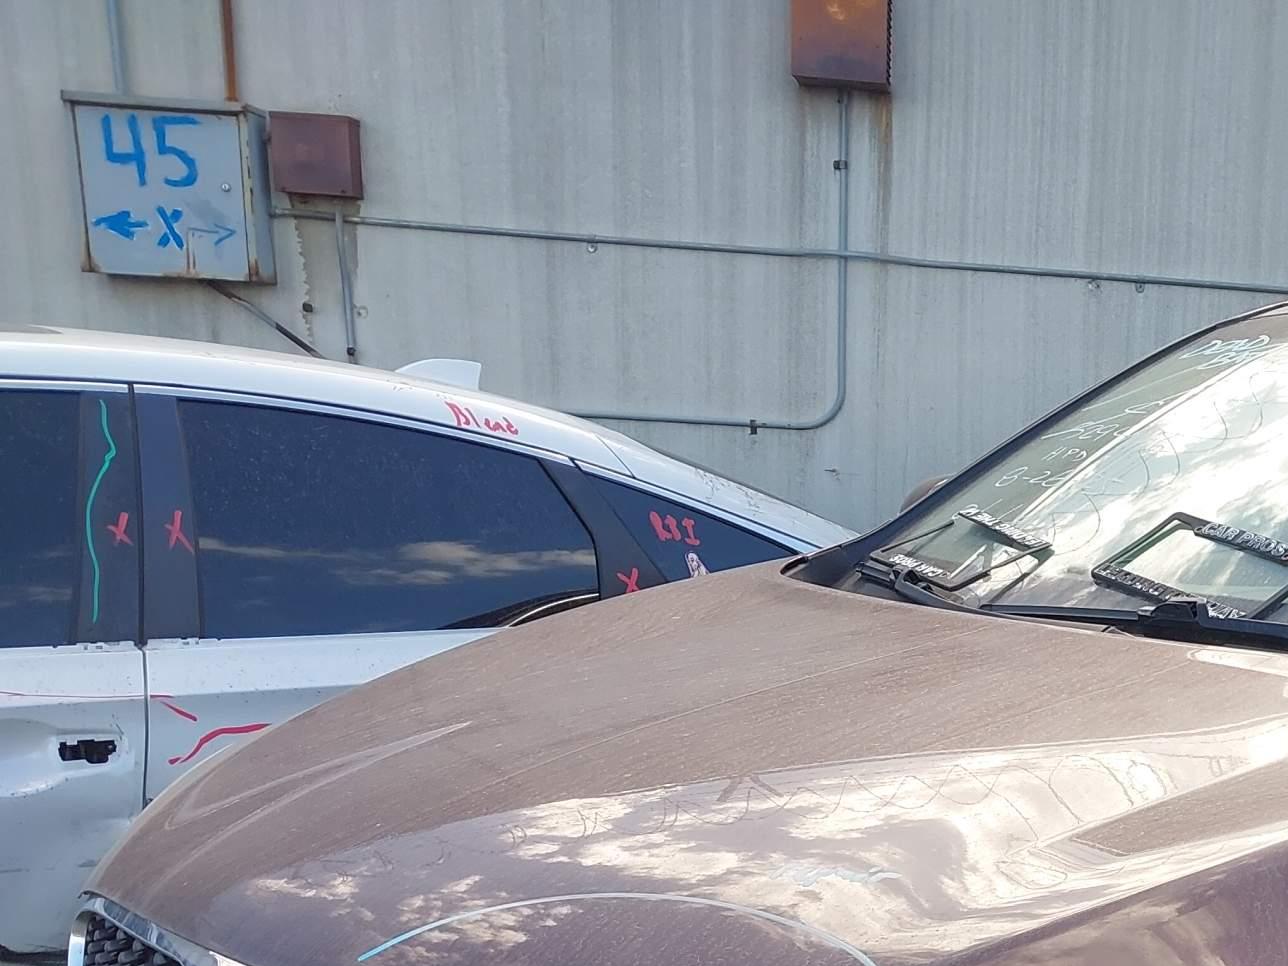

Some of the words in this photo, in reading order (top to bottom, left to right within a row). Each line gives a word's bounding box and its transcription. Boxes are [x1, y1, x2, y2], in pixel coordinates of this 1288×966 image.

[101, 113, 200, 188] 45
[1202, 522, 1240, 541] CAR
[1235, 531, 1288, 557] PROS
